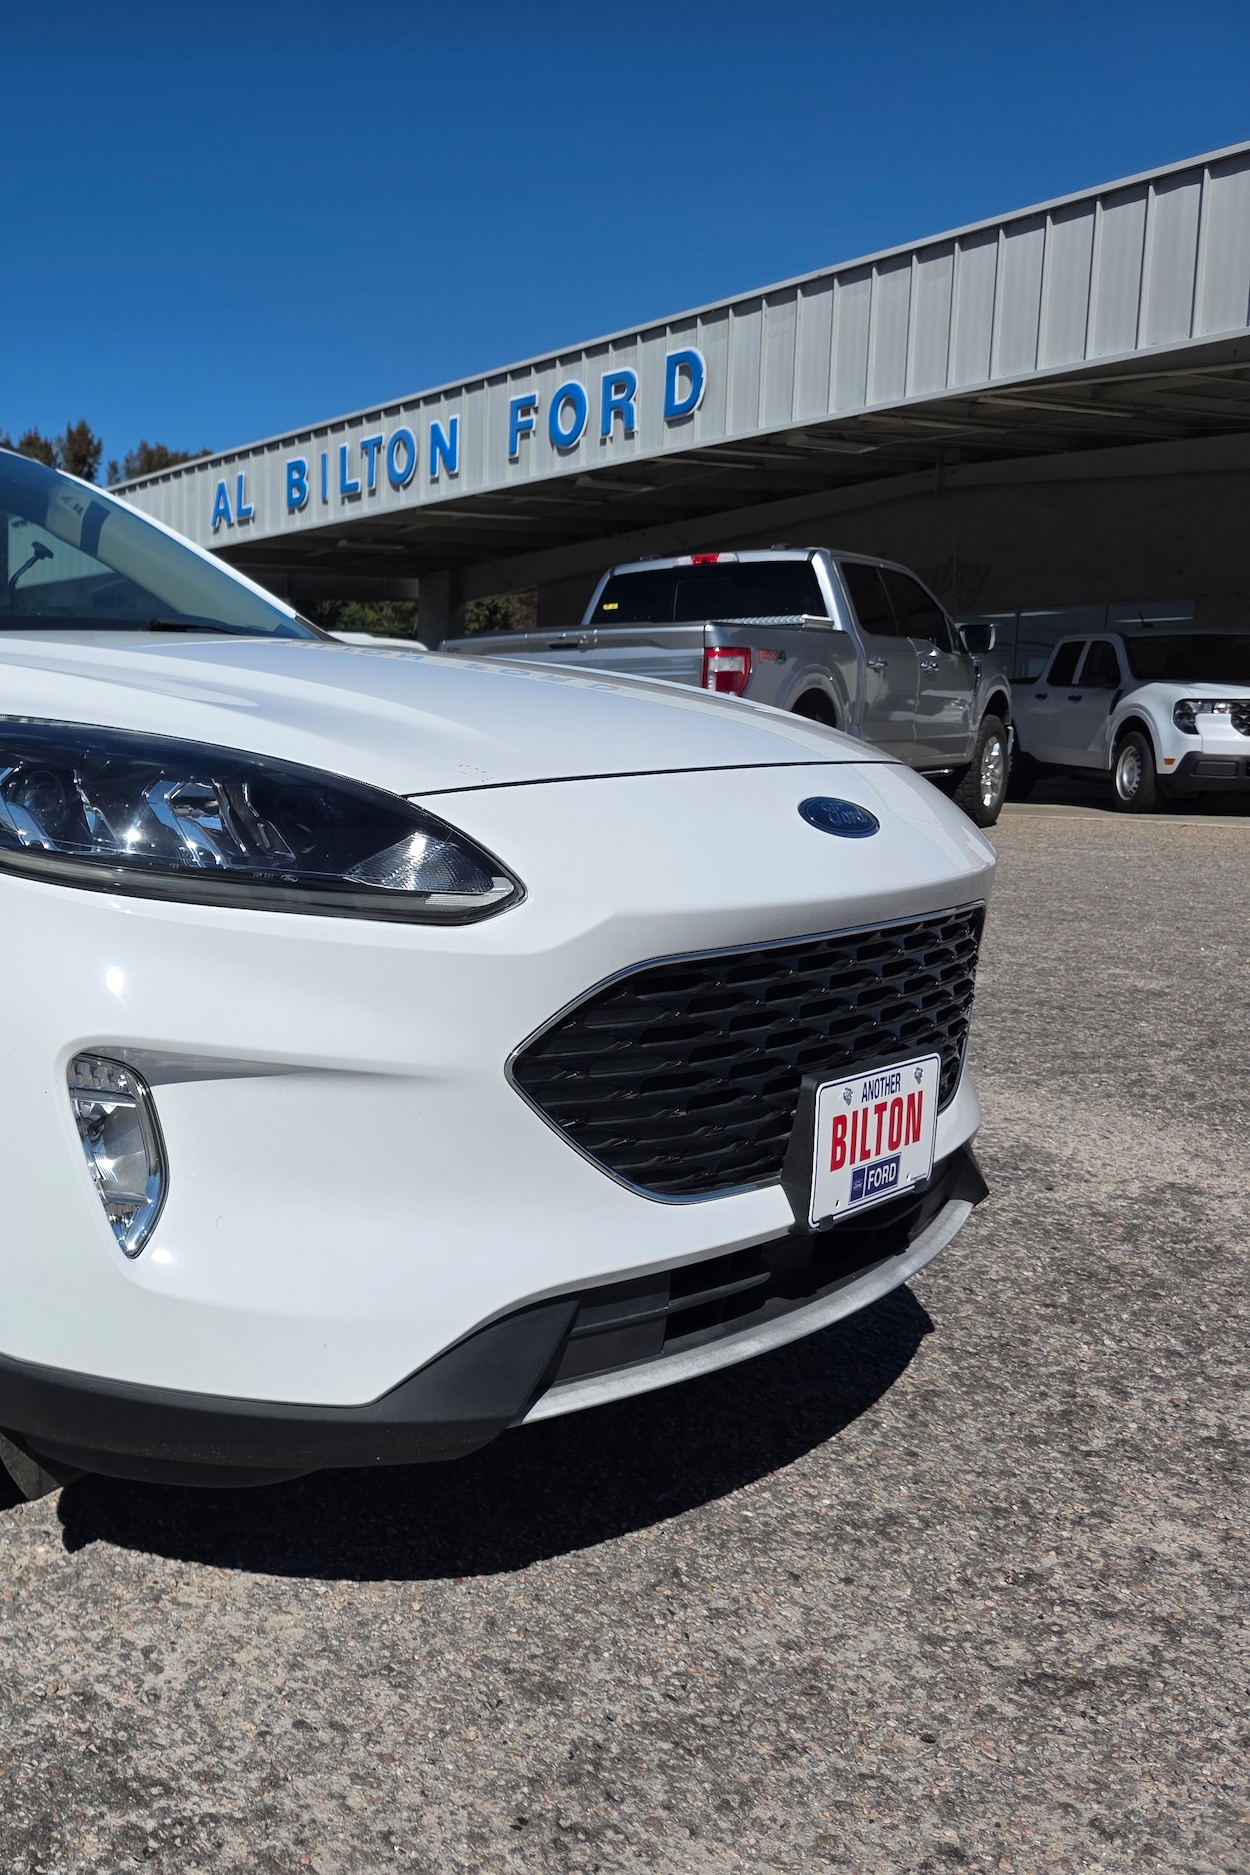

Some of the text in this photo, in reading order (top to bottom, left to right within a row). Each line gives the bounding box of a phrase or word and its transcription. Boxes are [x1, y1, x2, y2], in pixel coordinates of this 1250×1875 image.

[211, 347, 707, 529] AL BILTON FORD
[757, 649, 787, 665] FX4
[861, 1072, 901, 1103] ANOTHER
[830, 1090, 924, 1173] BILTON
[867, 1162, 897, 1191] FORD
